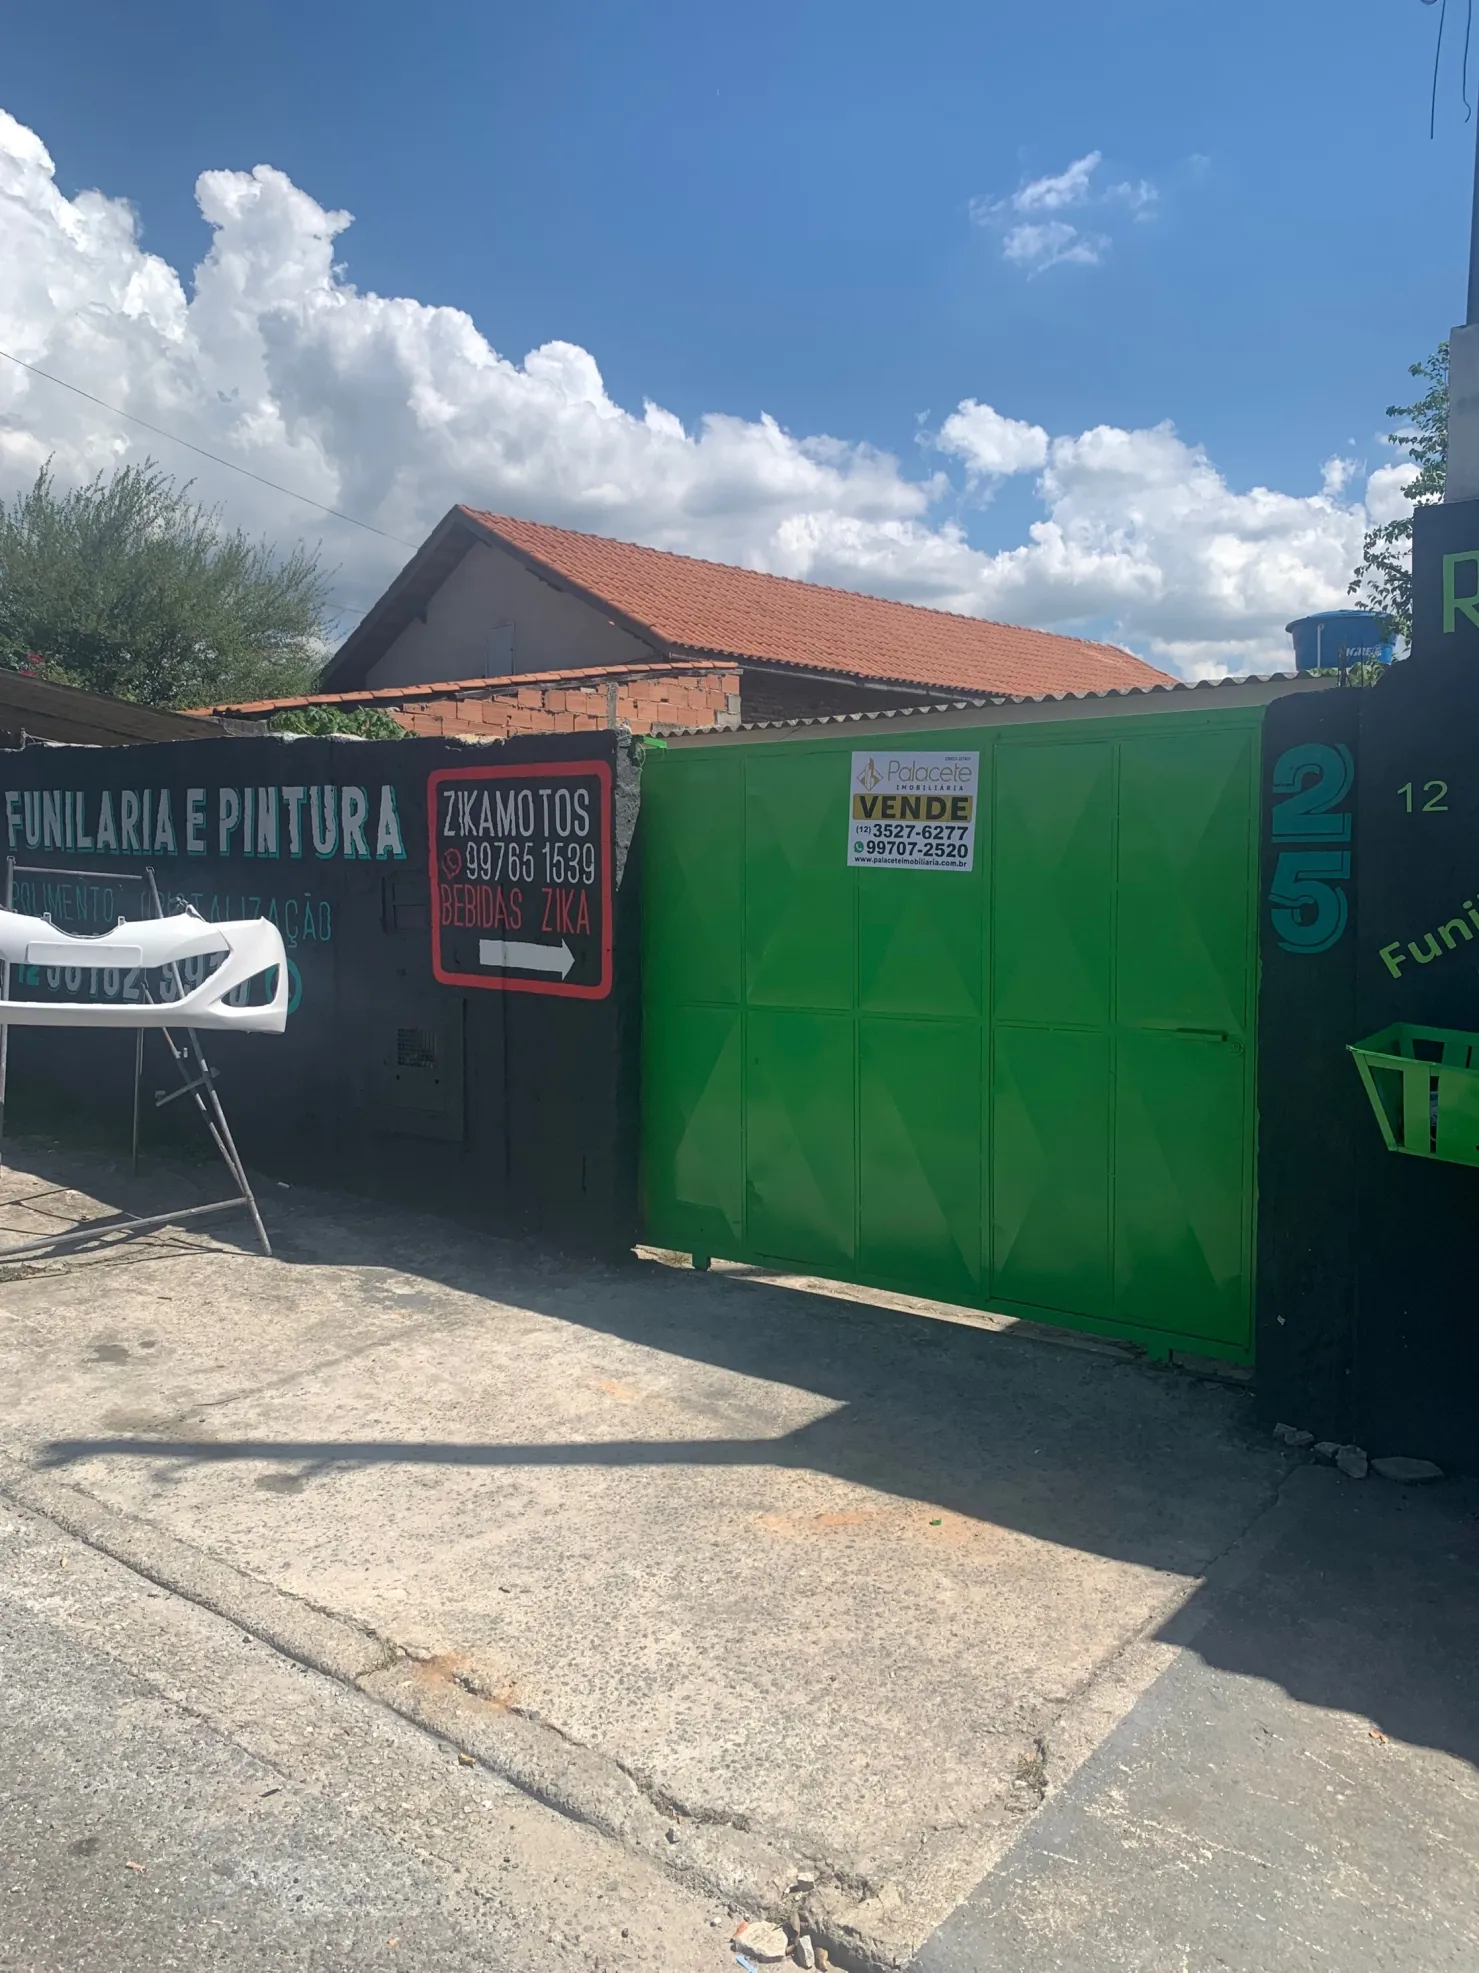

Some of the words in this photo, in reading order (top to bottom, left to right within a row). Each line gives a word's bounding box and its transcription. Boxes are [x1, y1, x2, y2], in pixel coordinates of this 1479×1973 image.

[1339, 647, 1372, 657] IGRE
[888, 760, 972, 782] Palacete
[859, 796, 969, 820] VENDE
[1397, 780, 1448, 812] 12
[5, 788, 178, 855] FUNILARIA
[186, 788, 207, 856] E
[219, 785, 407, 859] PINTURA
[856, 826, 871, 835] (12)
[873, 824, 968, 840] 3527-6277
[466, 842, 534, 881] 99765
[542, 842, 595, 884] 1539
[854, 856, 967, 867] www.palaceteimobiliaria.com.br
[866, 840, 968, 858] 99707-2520
[12, 881, 115, 922] POLIMENTO
[441, 884, 522, 929] BEBIDAS
[541, 888, 590, 934] ZIKA
[1379, 894, 1479, 979] Funi
